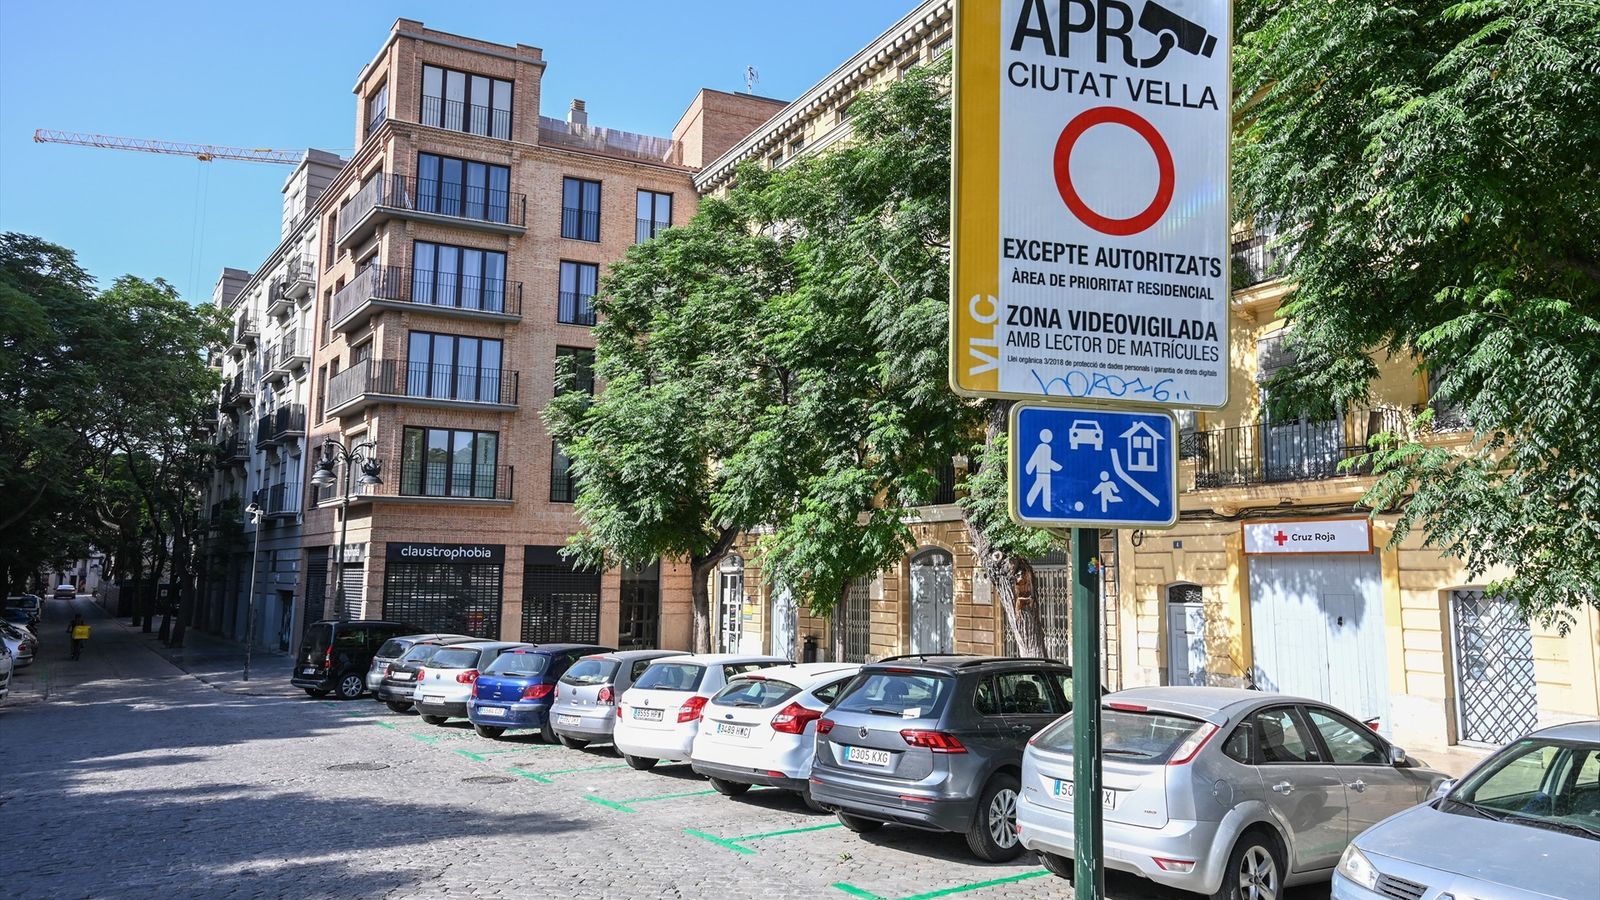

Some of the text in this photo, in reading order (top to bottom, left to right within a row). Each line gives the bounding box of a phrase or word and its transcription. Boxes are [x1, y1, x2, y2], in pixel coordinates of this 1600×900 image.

[1010, 0, 1137, 68] APR
[1007, 61, 1219, 110] CIUTAT VELLA
[1003, 238, 1221, 278] EXCEPTE AUTORITZATS
[1012, 267, 1214, 300] ÀREA DE PRIORITAT RESIDENCIAL
[969, 294, 1000, 376] VLC
[1006, 305, 1219, 342] ZONA VIDEOVIGILADA
[1006, 331, 1219, 362] AMB LECTOR DE MATRÍCULES
[1019, 355, 1043, 365] orgànica
[1044, 357, 1064, 366] 3/2018
[1065, 359, 1072, 367] de
[1073, 360, 1098, 370] protecció
[1107, 362, 1123, 370] dades
[1124, 364, 1150, 373] personals
[1154, 366, 1176, 374] garantia
[1184, 367, 1198, 376] drets
[1199, 368, 1218, 377] digitals
[401, 545, 492, 560] claustrophobia
[1291, 532, 1336, 542] Cruz Roja
[720, 723, 735, 735] 3489
[872, 751, 889, 764] KXG
[1061, 784, 1074, 797] 50
